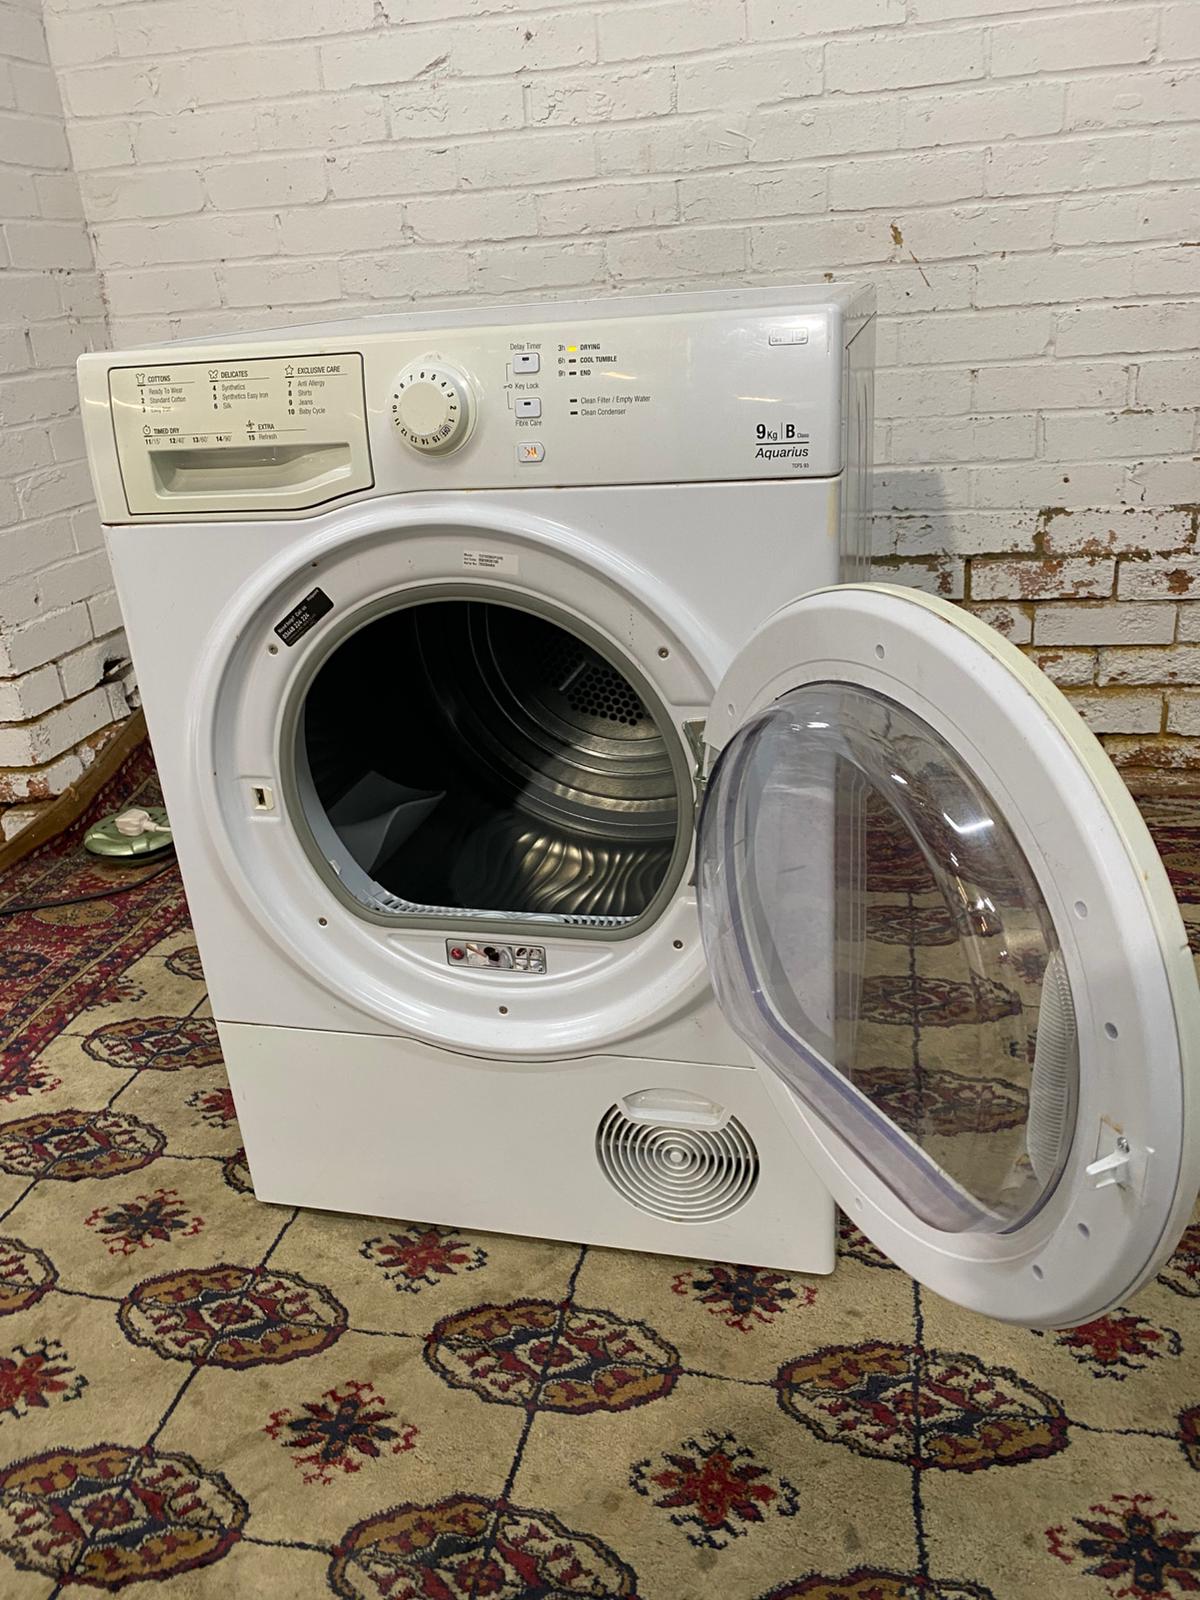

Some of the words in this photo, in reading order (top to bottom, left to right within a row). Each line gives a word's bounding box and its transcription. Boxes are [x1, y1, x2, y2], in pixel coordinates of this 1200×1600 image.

[510, 342, 525, 352] Delay
[526, 342, 542, 350] Timer
[221, 370, 248, 378] DELICATES
[514, 383, 526, 391] Key
[580, 396, 596, 404] Clean
[596, 396, 610, 404] Filter
[616, 395, 634, 404] Empty
[786, 424, 796, 438] B
[755, 446, 808, 460] Aquarius
